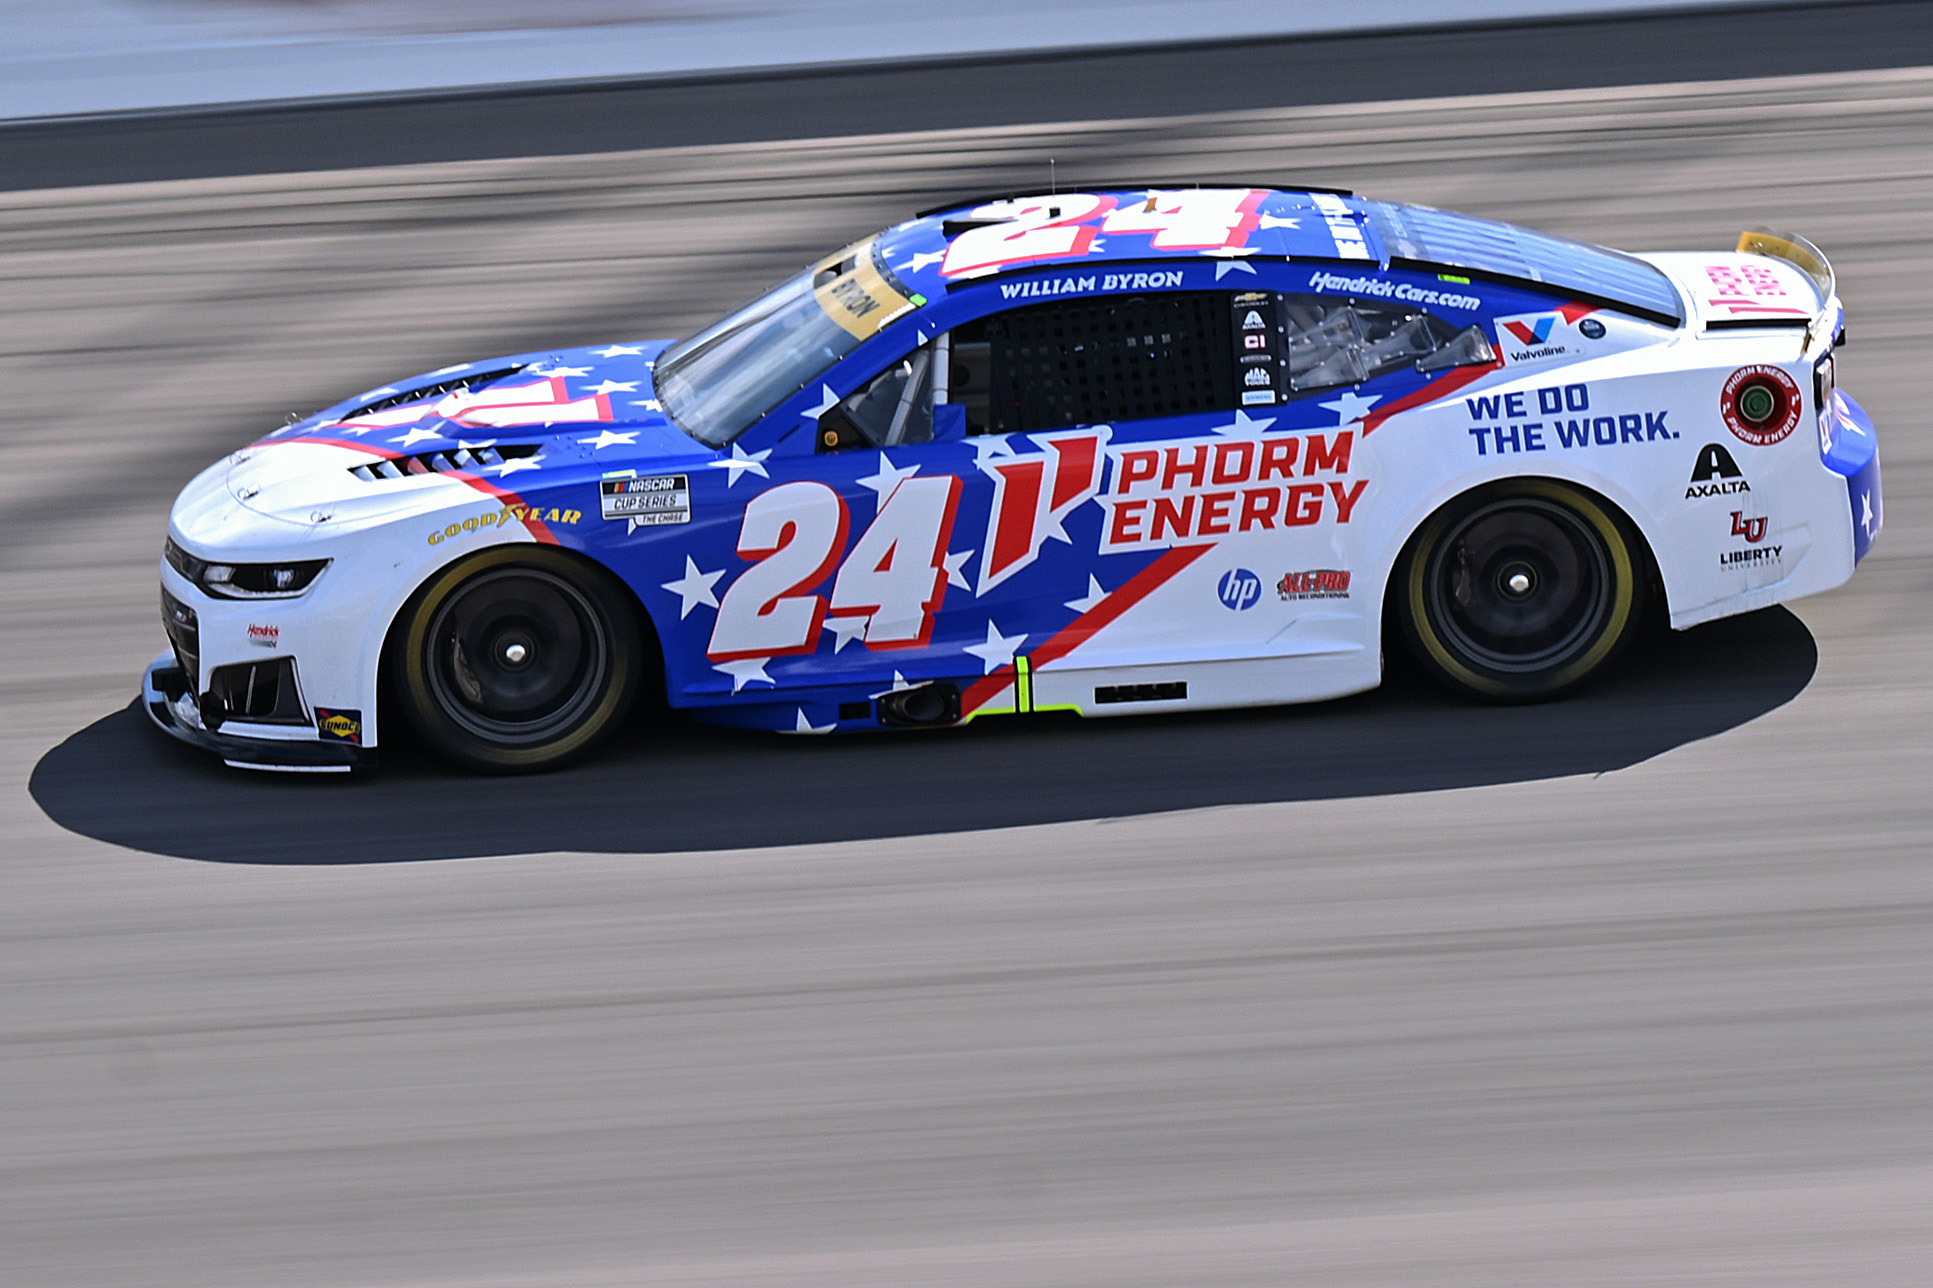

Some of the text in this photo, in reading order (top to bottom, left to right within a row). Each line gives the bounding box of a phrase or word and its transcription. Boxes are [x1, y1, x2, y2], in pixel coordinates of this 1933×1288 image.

[939, 188, 1270, 276] 24
[1000, 271, 1184, 300] WILLIAM BYRON
[1511, 345, 1566, 362] Valvoline
[1725, 366, 1756, 396] PHORM
[1465, 383, 1590, 421] WE DO
[1469, 411, 1680, 455] THE WORK.
[1726, 410, 1798, 444] PHORM ENERGY
[1117, 430, 1354, 494] PHORM
[628, 478, 675, 493] NASCAR
[1684, 480, 1752, 500] AXALTA
[614, 493, 677, 510] CUP SERIES
[1109, 479, 1370, 545] ENERGY
[642, 512, 684, 524] THE CHASE
[1730, 510, 1769, 543] LU
[706, 474, 963, 663] 24
[1720, 545, 1783, 565] LIBERTY
[1720, 558, 1783, 572] UNIVERSITY
[1221, 568, 1259, 611] hp
[1278, 570, 1351, 595] ALL-PRO
[318, 718, 361, 735] SUNOCO
